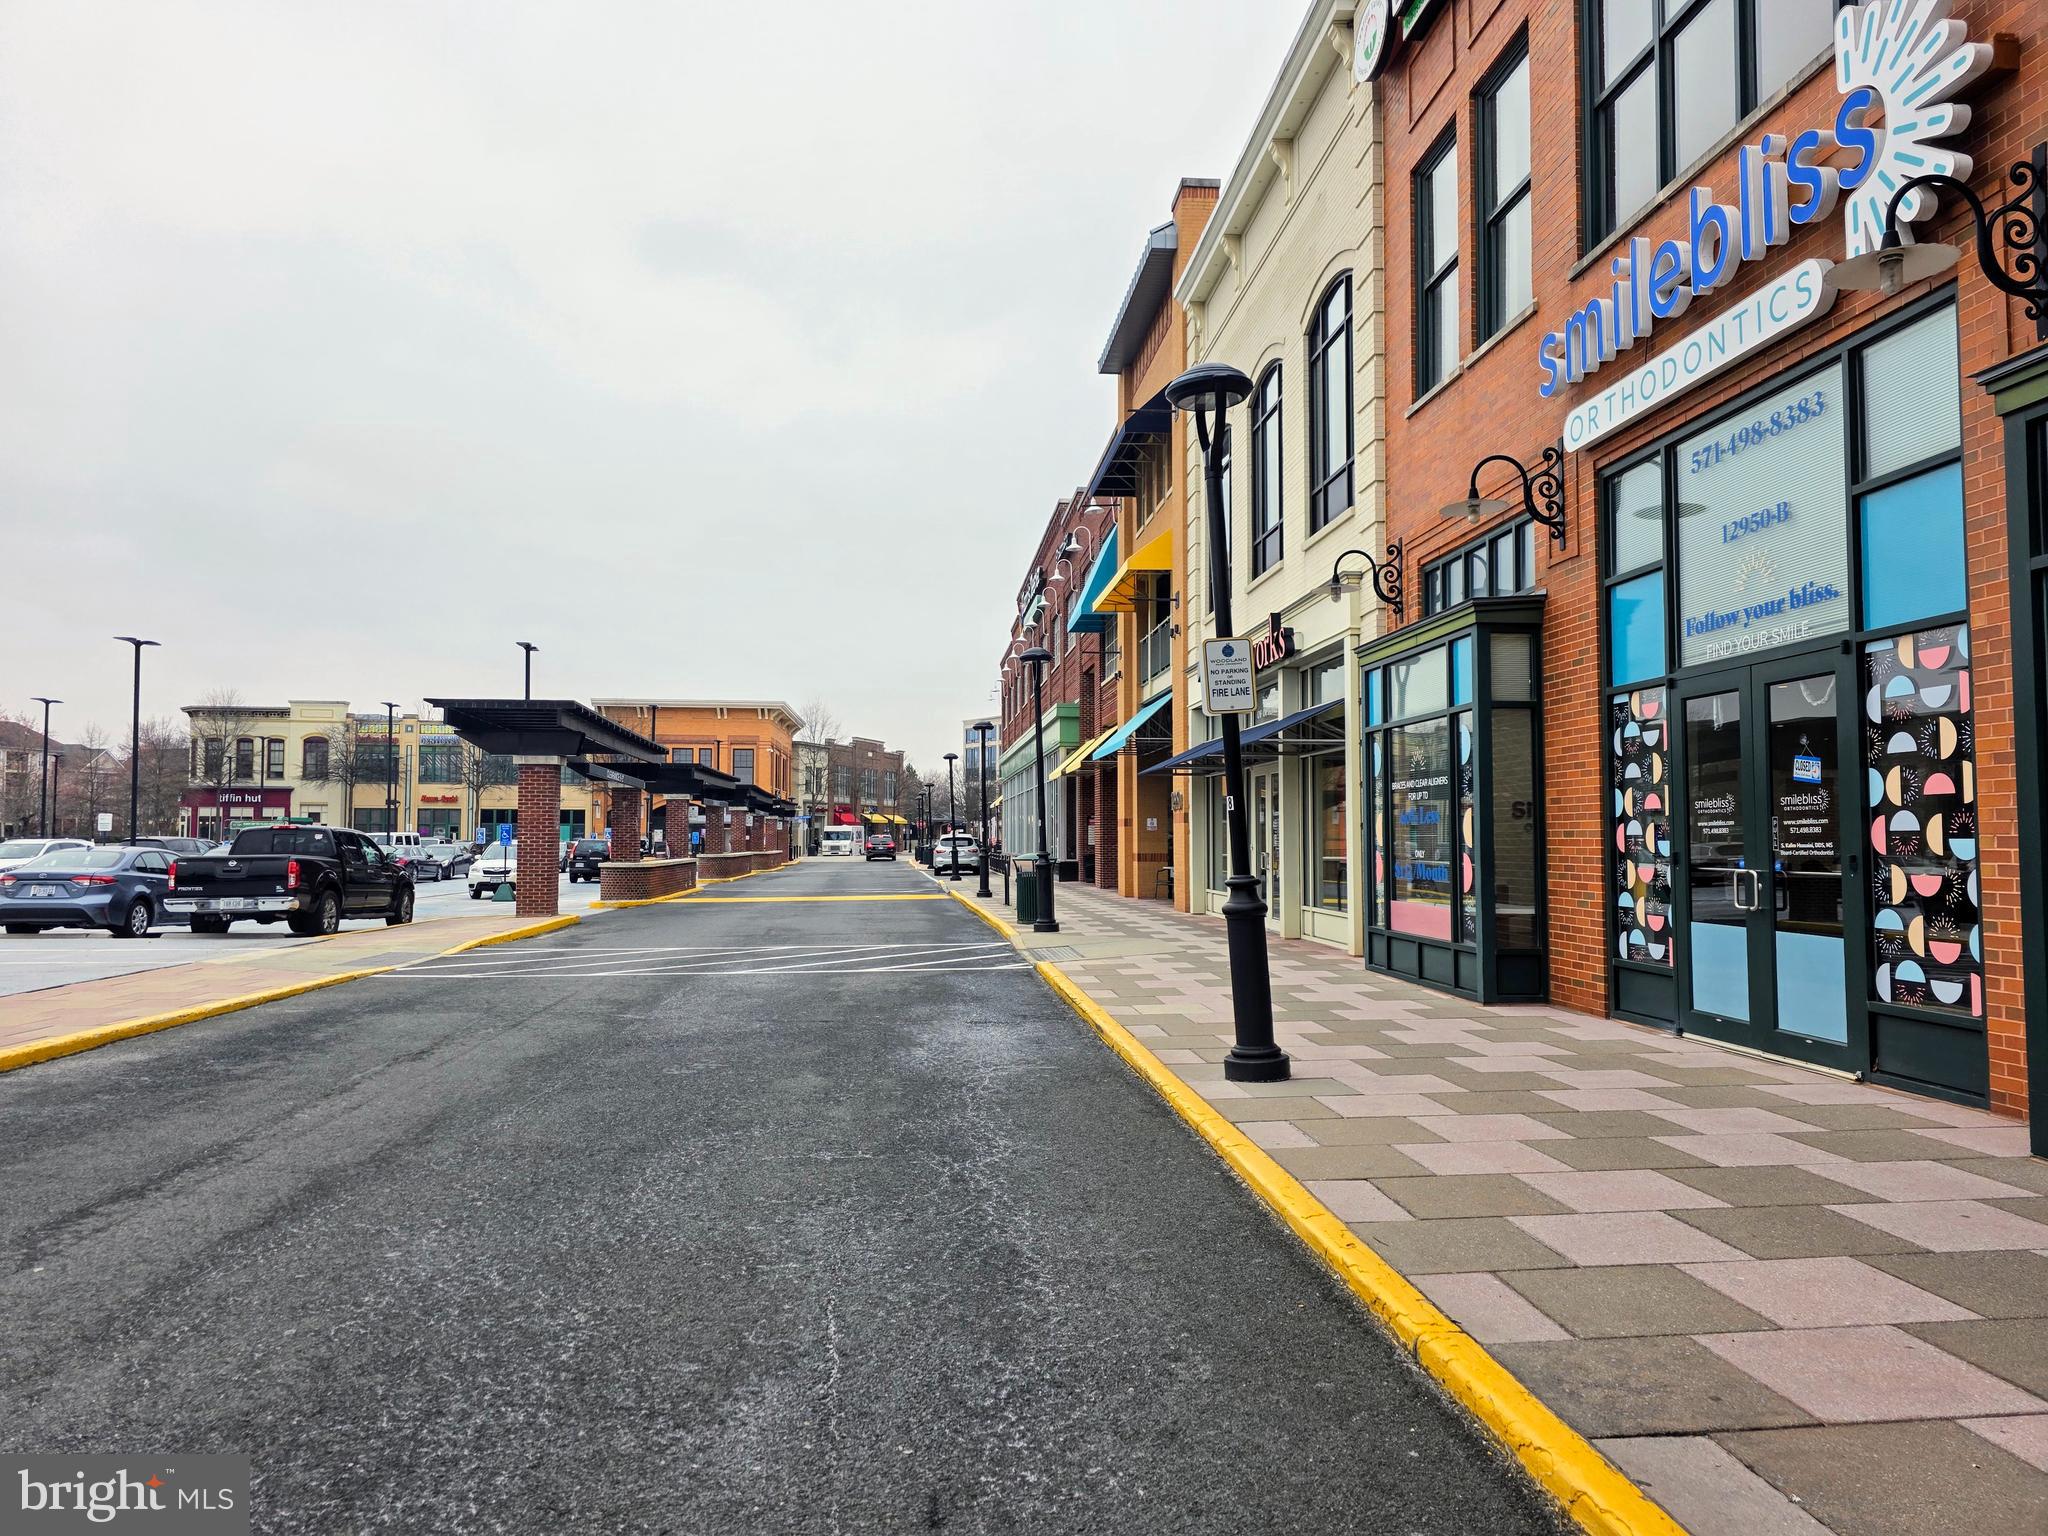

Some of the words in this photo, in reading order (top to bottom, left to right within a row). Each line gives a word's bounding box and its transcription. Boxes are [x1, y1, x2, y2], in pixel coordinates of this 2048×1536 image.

[1539, 88, 1879, 397] smilebliss
[1569, 270, 1813, 443] ORTHODONTICS
[1691, 391, 1825, 474] 571-498-8383
[1722, 501, 1790, 544] 12950-B
[1685, 610, 1740, 637] Follow
[1743, 597, 1786, 629] your
[1789, 581, 1841, 610] bliss.
[1253, 613, 1286, 670] orks
[1706, 640, 1732, 659] FIND
[1735, 631, 1769, 651] YOUR
[1772, 620, 1813, 644] SMILE.
[1212, 688, 1229, 697] FIRE
[1230, 687, 1250, 696] LANE
[1392, 781, 1406, 790] BRACES
[1416, 778, 1428, 787] CLEAR
[1429, 776, 1448, 786] ALIGNERS
[220, 793, 242, 802] tiffin
[245, 793, 262, 802] hut
[1408, 792, 1416, 800] FOR
[1417, 792, 1422, 800] UP
[1423, 791, 1428, 799] TO
[1780, 793, 1822, 806] smilebliss
[1228, 797, 1232, 809] 8
[1694, 798, 1729, 809] smilebliss
[1415, 850, 1425, 858] ONLY
